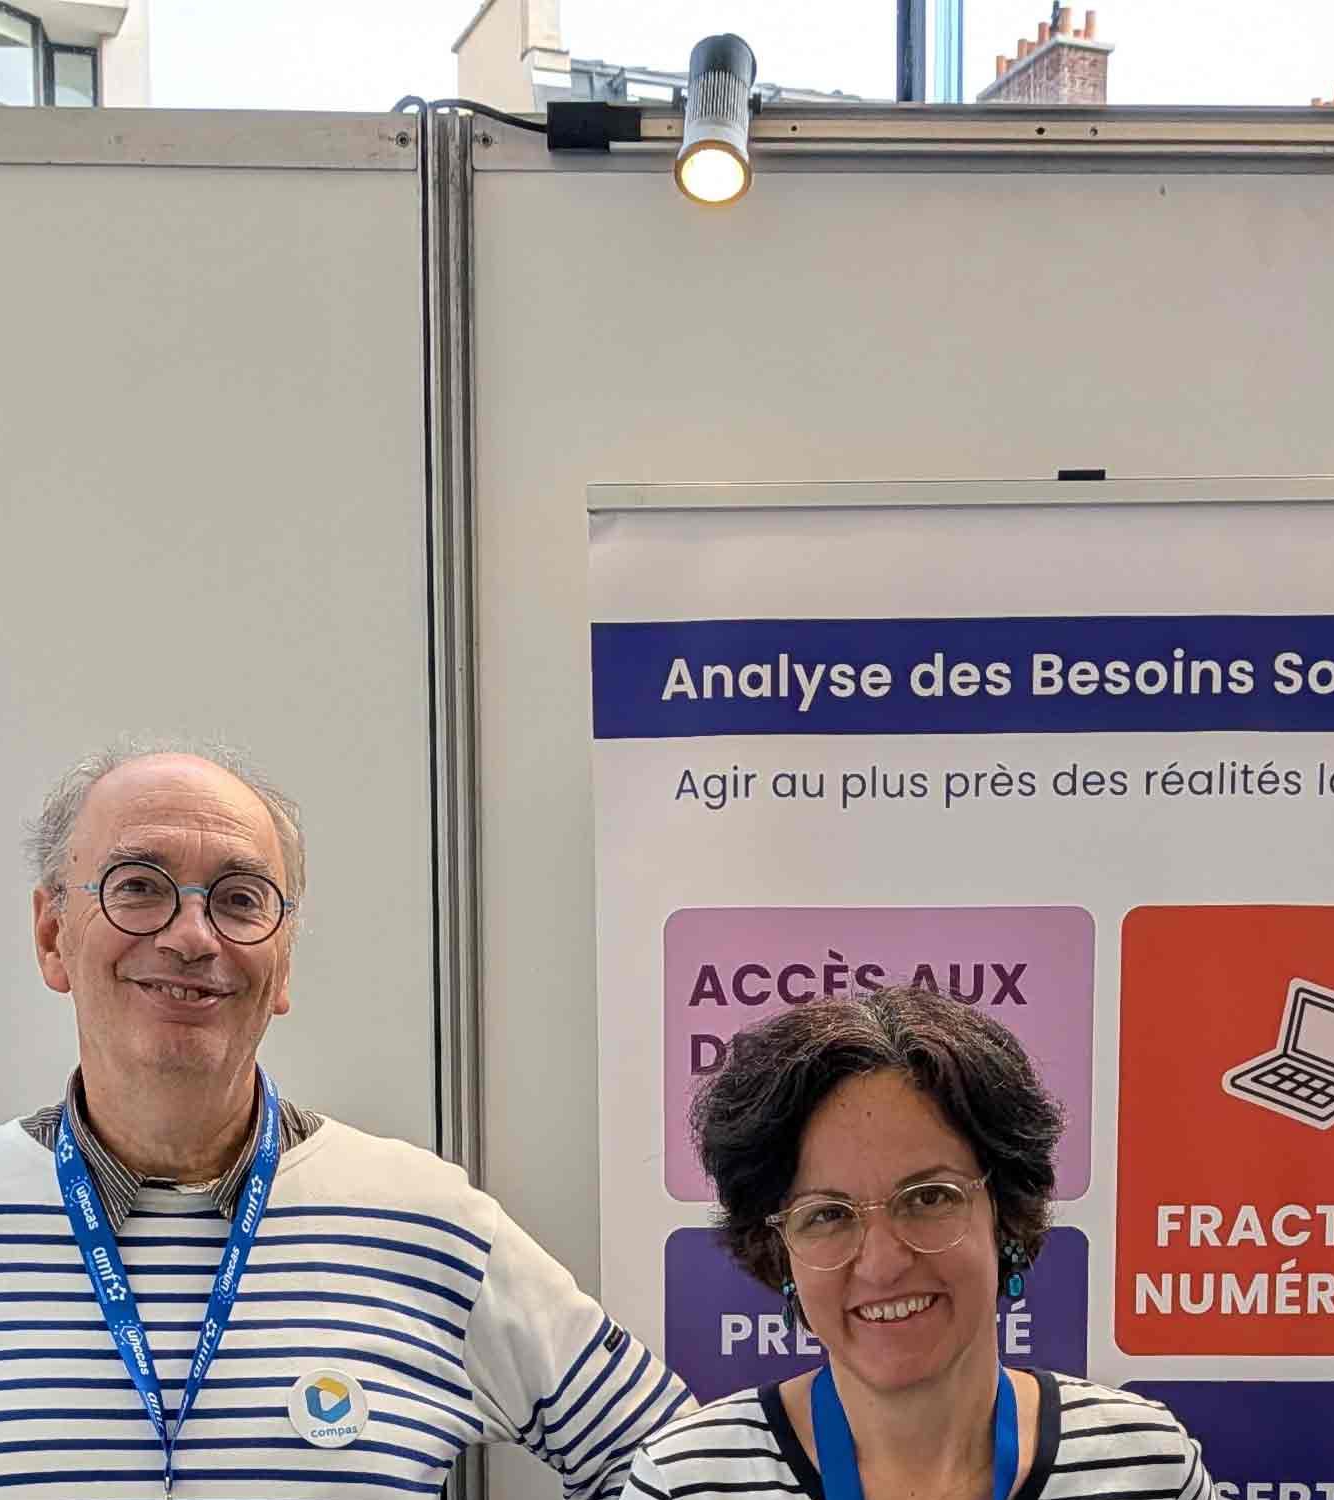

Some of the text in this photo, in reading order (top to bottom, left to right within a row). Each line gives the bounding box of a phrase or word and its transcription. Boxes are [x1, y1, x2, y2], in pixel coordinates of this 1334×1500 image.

[662, 653, 893, 712] Analyse
[910, 652, 1013, 698] des
[1032, 648, 1255, 696] Besoins
[675, 765, 757, 810] Agir
[772, 771, 825, 798] au
[842, 766, 929, 808] plus
[945, 763, 1036, 808] près
[1052, 763, 1129, 796] des
[1145, 761, 1303, 796] réalités
[688, 949, 1028, 1007] ACCÈS AUX
[75, 1184, 100, 1231] unccas
[241, 1191, 260, 1233] amf
[92, 1246, 122, 1281] amf
[220, 1246, 240, 1292] unccas
[126, 1329, 150, 1376] unccas
[193, 1333, 212, 1378] amf
[310, 1424, 359, 1438] compas
